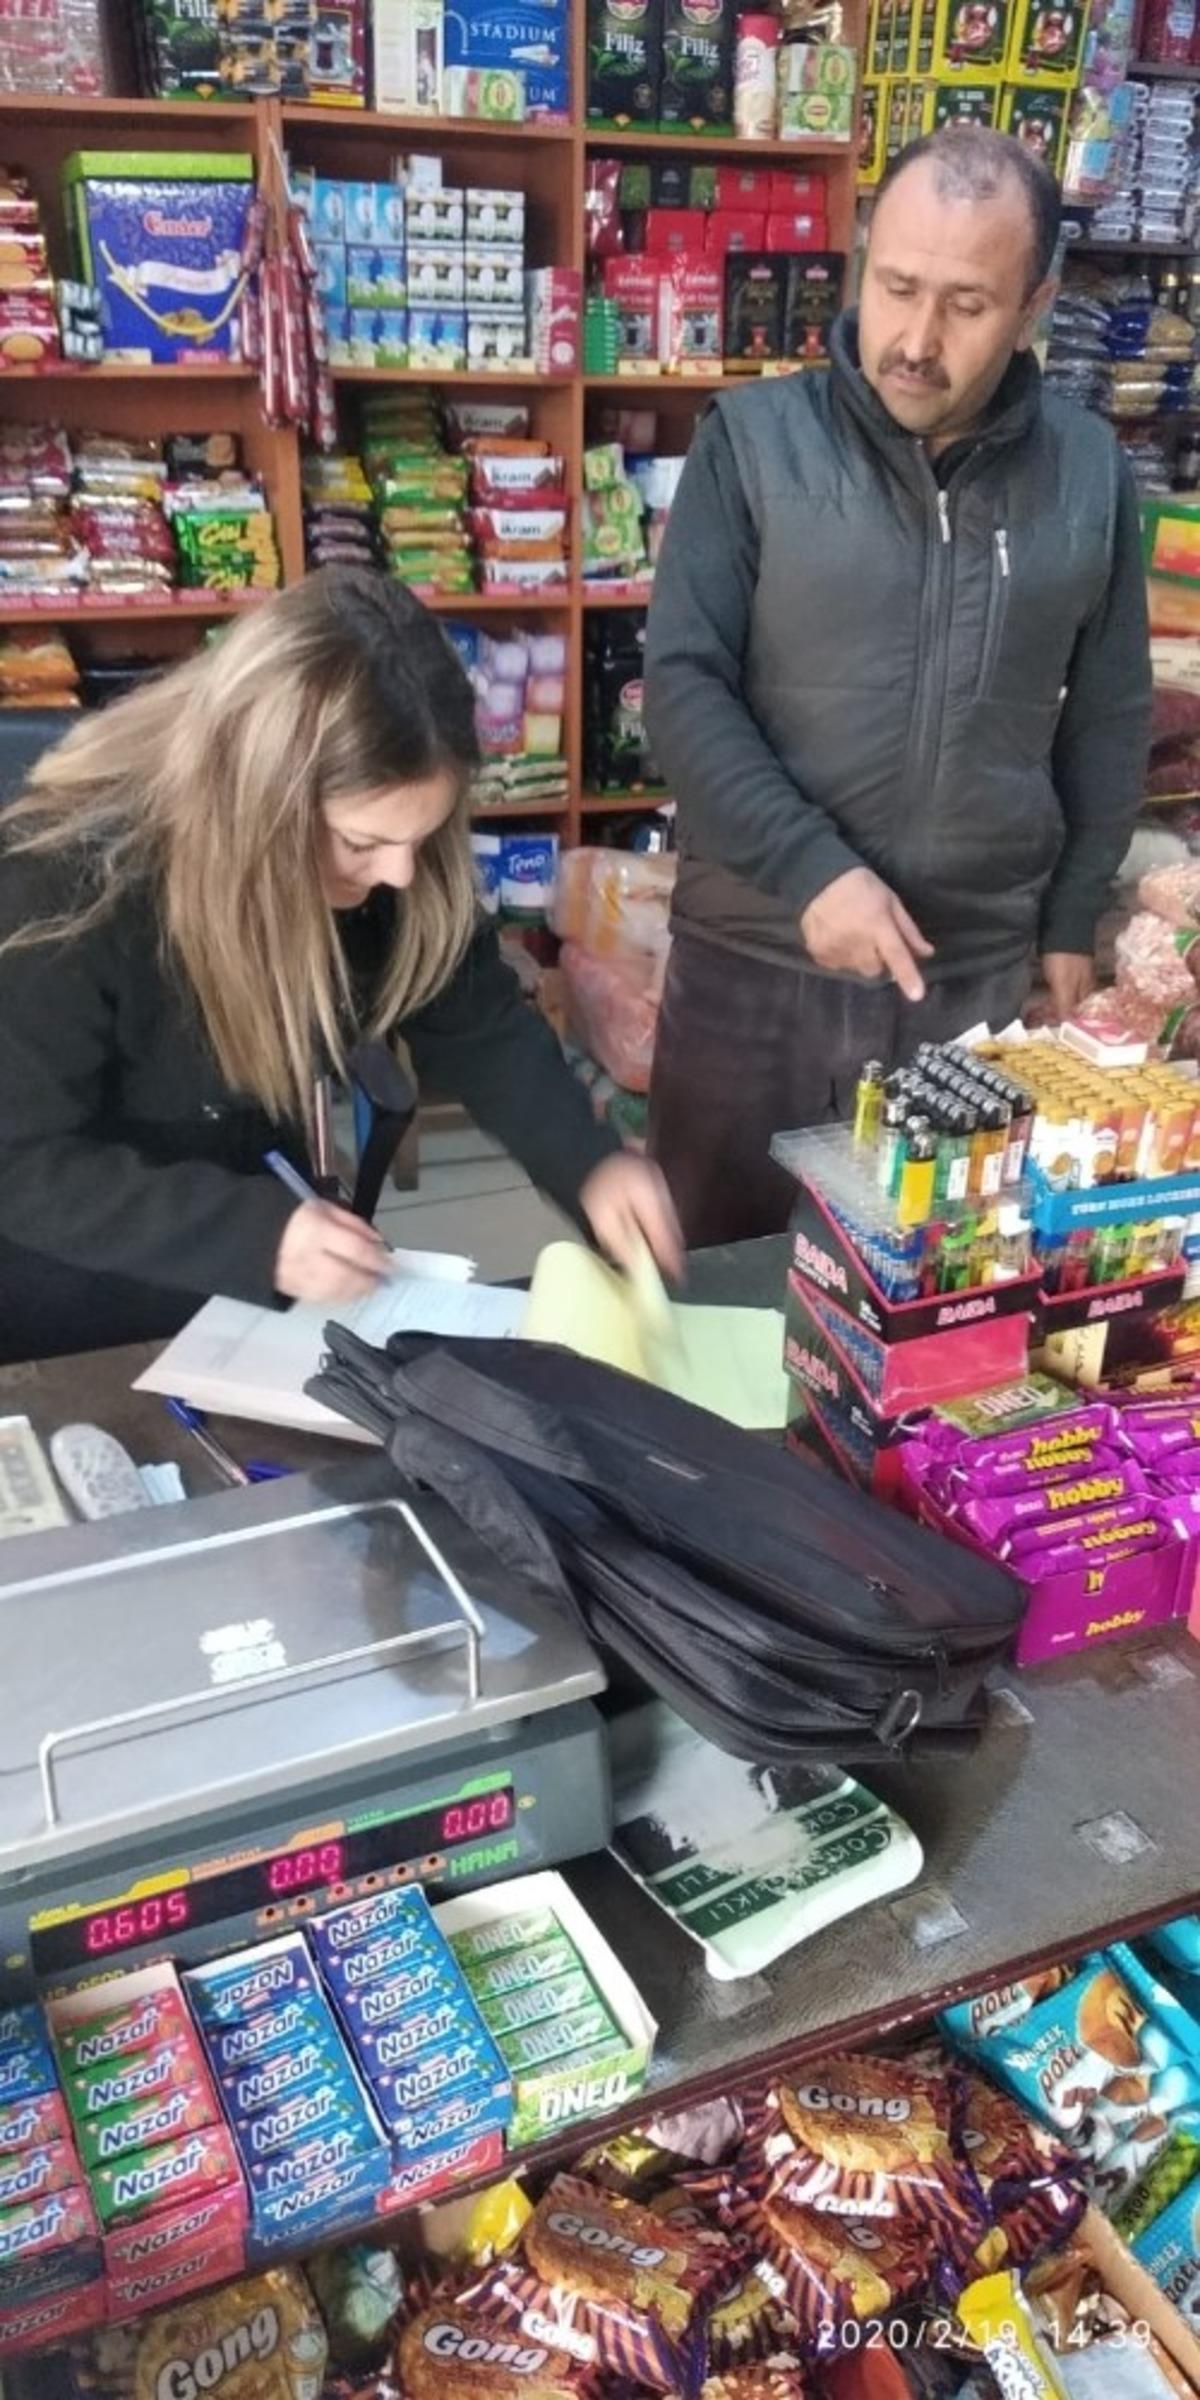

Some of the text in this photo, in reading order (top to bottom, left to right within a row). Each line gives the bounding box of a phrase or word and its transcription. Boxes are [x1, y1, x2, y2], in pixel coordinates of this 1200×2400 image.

[469, 23, 556, 42] STADIUM
[604, 32, 646, 54] Filiz
[680, 34, 721, 58] Filiz
[1047, 1477, 1124, 1510] hobby
[1086, 1610, 1146, 1637] hobby
[88, 1892, 187, 1949] 0.605
[270, 1845, 341, 1890] 0.00
[444, 1795, 508, 1840] 0.00
[329, 1896, 401, 1946] Nazar
[474, 1922, 524, 1952] ONEO
[344, 1929, 420, 1983] Nazar
[489, 1956, 541, 1988] ONEO
[361, 1966, 437, 2022] Nazar
[503, 1989, 557, 2023] ONEO
[77, 2007, 159, 2066] Nazar
[223, 2004, 304, 2061] Nazar
[379, 2005, 455, 2062] Nazar
[521, 2022, 578, 2057] ONEO
[89, 2051, 174, 2110] Nazar
[239, 2046, 322, 2107] Nazar
[395, 2045, 475, 2104] Nazar
[539, 2073, 629, 2122] ONEO
[100, 2094, 188, 2156] Nazar
[253, 2085, 336, 2148] Nazar
[409, 2101, 488, 2149] Nazar
[797, 2083, 911, 2122] Gong
[114, 2139, 207, 2205] Nazar
[268, 2129, 352, 2190] Nazar
[398, 2142, 477, 2192] Nazar
[276, 2163, 360, 2219] Nazar
[127, 2206, 216, 2263] Nazar
[547, 2212, 667, 2267] Gong
[157, 2307, 278, 2400] Gong
[424, 2323, 549, 2374] Gong
[521, 2308, 597, 2361] Gong
